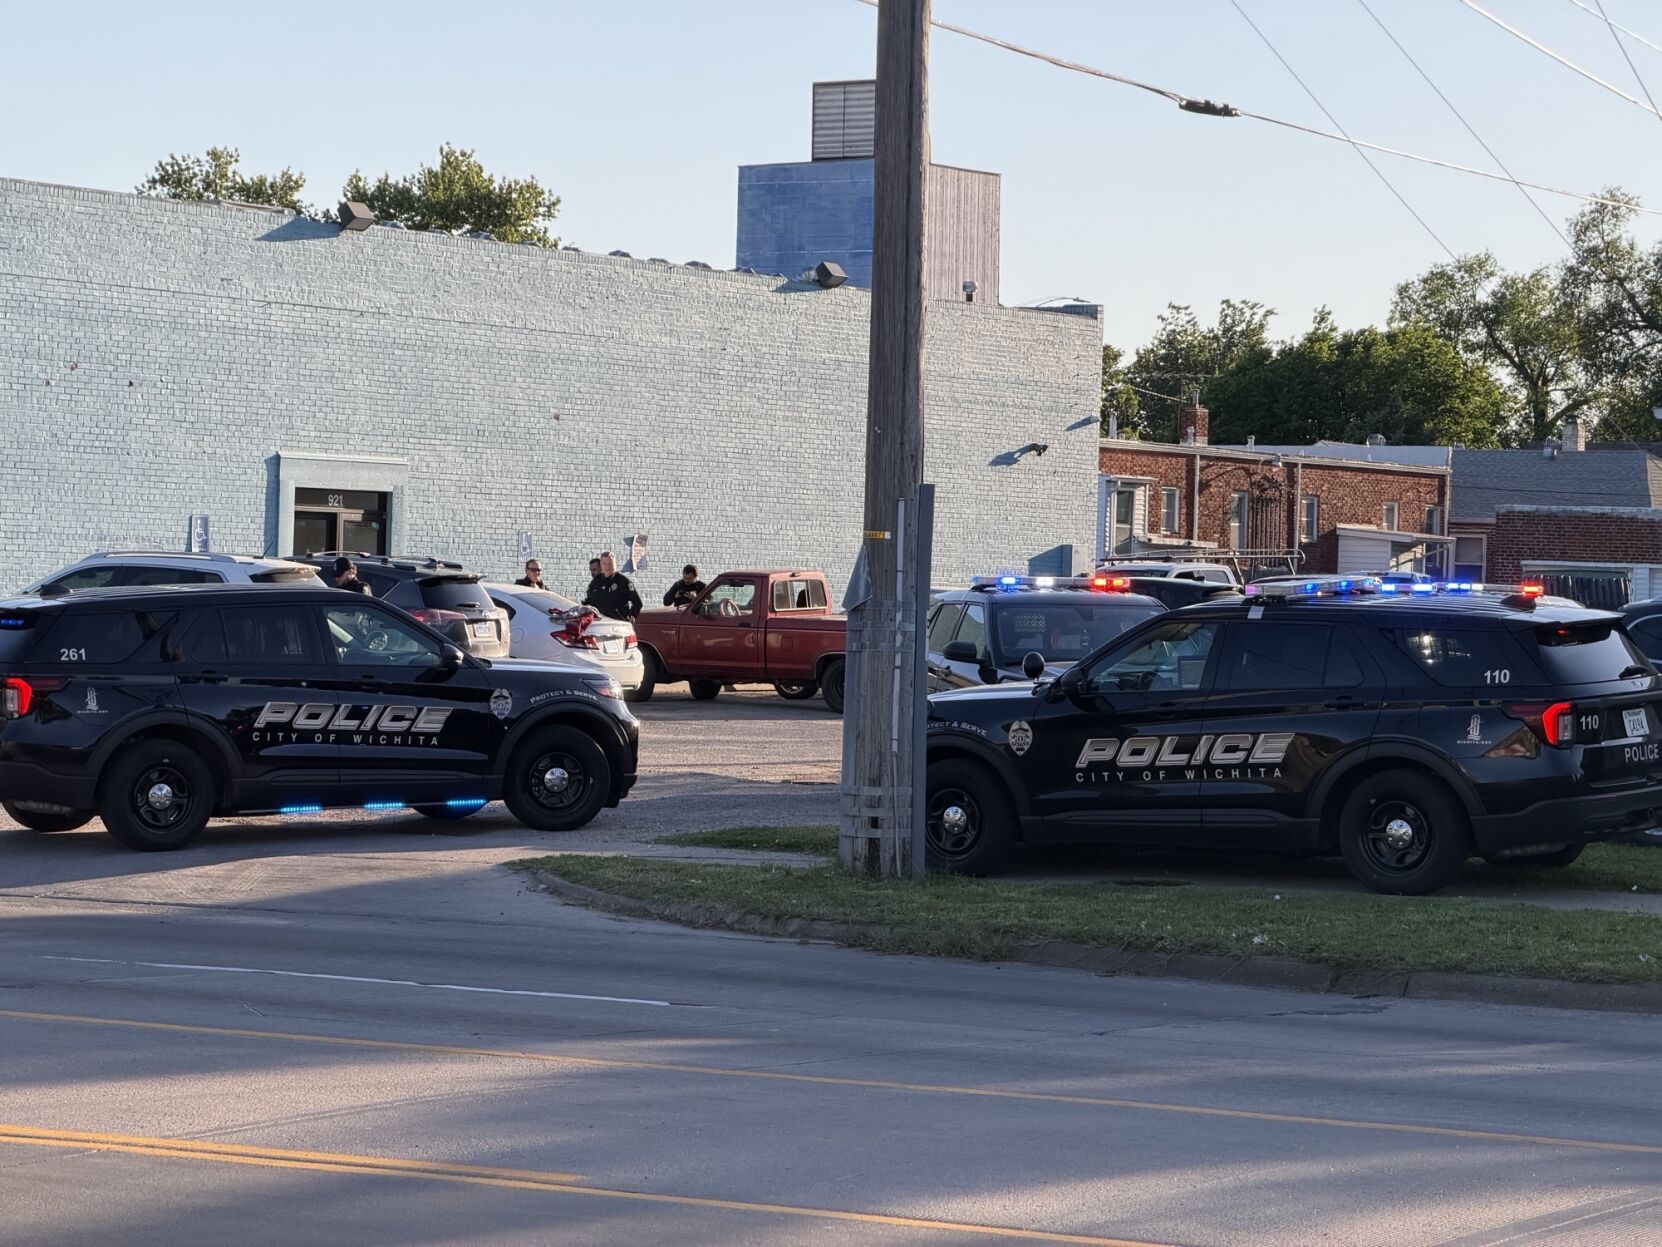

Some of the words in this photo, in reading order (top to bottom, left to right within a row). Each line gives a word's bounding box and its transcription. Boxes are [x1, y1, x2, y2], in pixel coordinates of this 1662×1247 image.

[328, 494, 343, 506] 921
[60, 648, 86, 661] 261
[1484, 669, 1510, 684] 110
[530, 690, 564, 703] PROTECT
[574, 690, 598, 701] SERVE
[253, 702, 453, 733] POLICE
[1580, 715, 1599, 730] 110
[961, 722, 988, 736] SERVE
[253, 732, 298, 742] CITY
[315, 733, 336, 743] OF
[353, 734, 438, 745] WICHITA
[1075, 732, 1295, 768] POLICE
[1625, 744, 1659, 763] POLICE
[1075, 772, 1124, 782] CITY
[1143, 771, 1167, 781] OF
[1185, 768, 1281, 780] WICHITA
